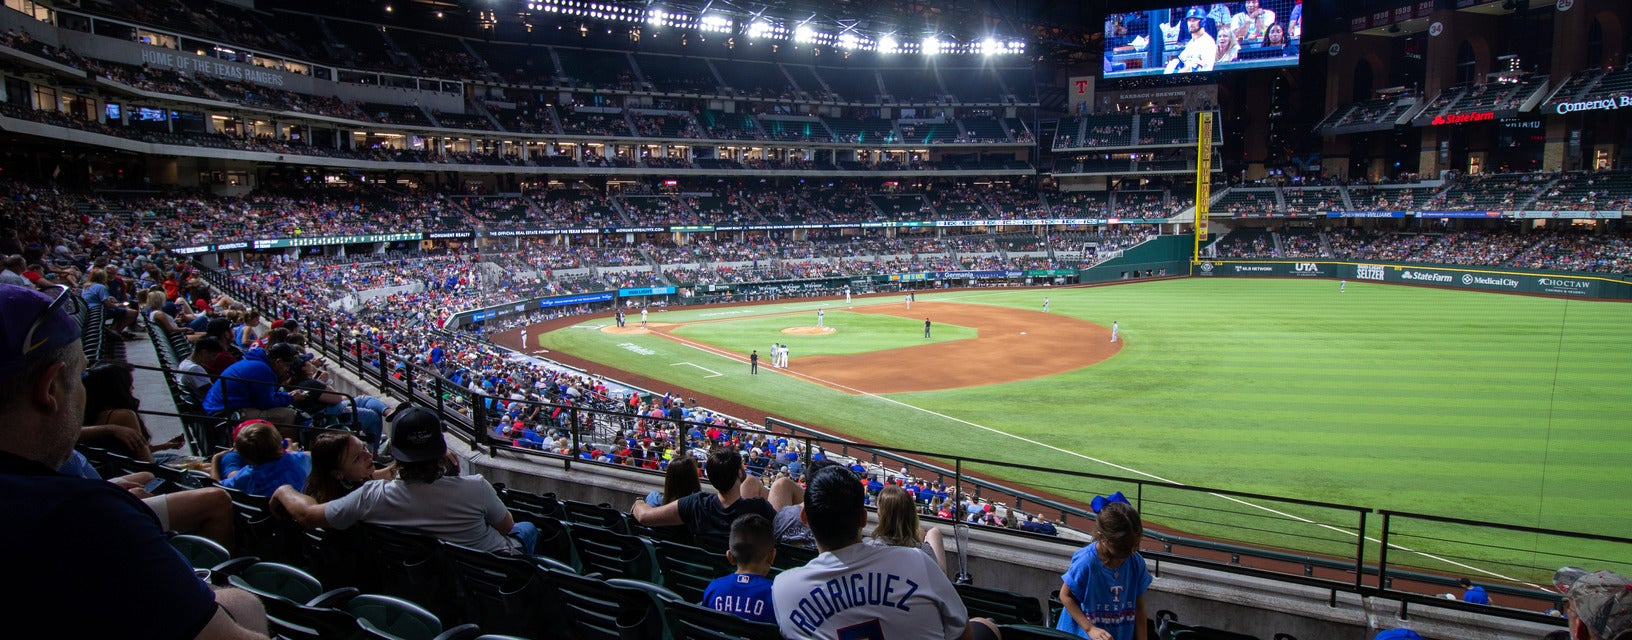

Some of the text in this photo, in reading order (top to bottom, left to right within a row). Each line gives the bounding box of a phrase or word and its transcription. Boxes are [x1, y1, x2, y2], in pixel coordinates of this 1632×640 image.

[1431, 25, 1441, 34] 34
[141, 49, 284, 86] HOME OF THE TEXAS RANGERS
[1075, 80, 1088, 95] T
[1295, 262, 1318, 271] UTA
[1357, 269, 1384, 280] SELTZER
[1474, 276, 1519, 288] Medical City
[1543, 278, 1590, 288] CHOCTAW
[1110, 586, 1124, 602] T
[715, 596, 764, 616] GALLO
[789, 572, 919, 637] RODRIGUEZ
